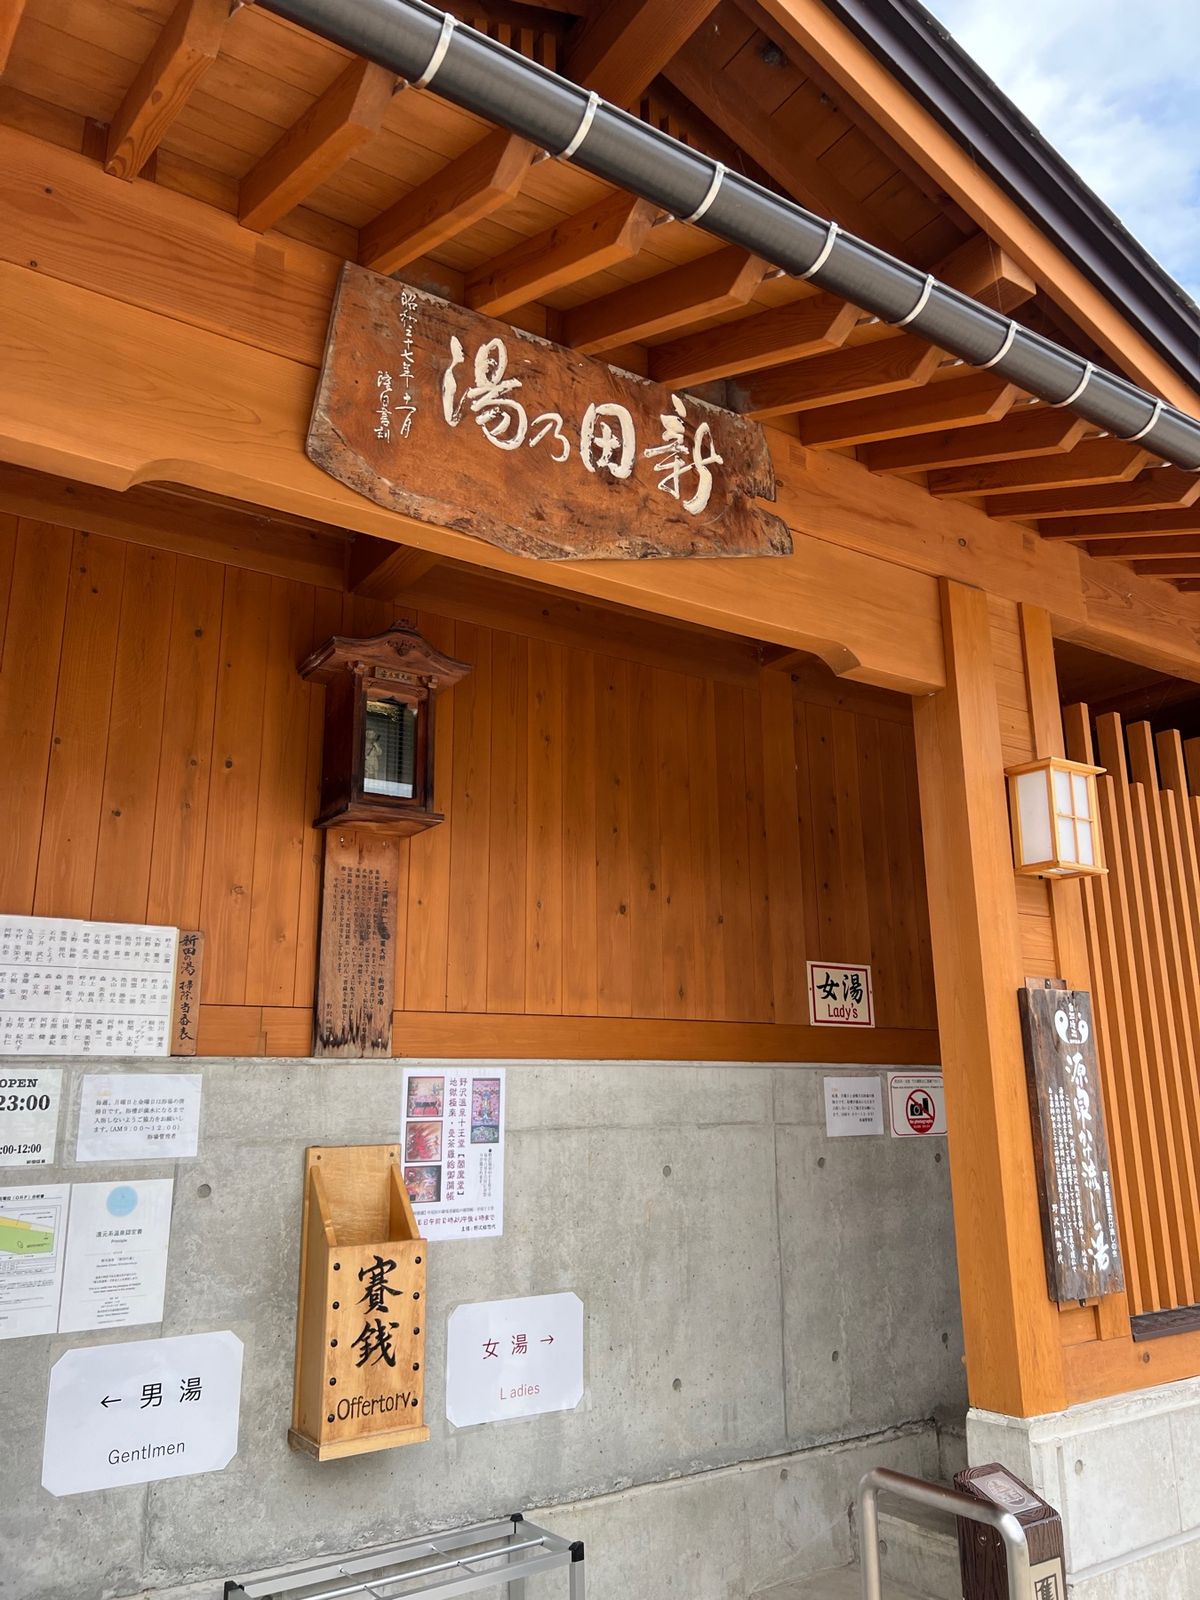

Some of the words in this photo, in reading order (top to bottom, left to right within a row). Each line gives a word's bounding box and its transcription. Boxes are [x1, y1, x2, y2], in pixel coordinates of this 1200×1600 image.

[816, 972, 863, 1004] 女湯
[827, 1003, 858, 1020] Lady's
[0, 1079, 38, 1088] OPEN
[351, 1255, 404, 1369] 賽銭
[338, 1393, 411, 1420] Offertory
[108, 1442, 185, 1465] Gentlmen
